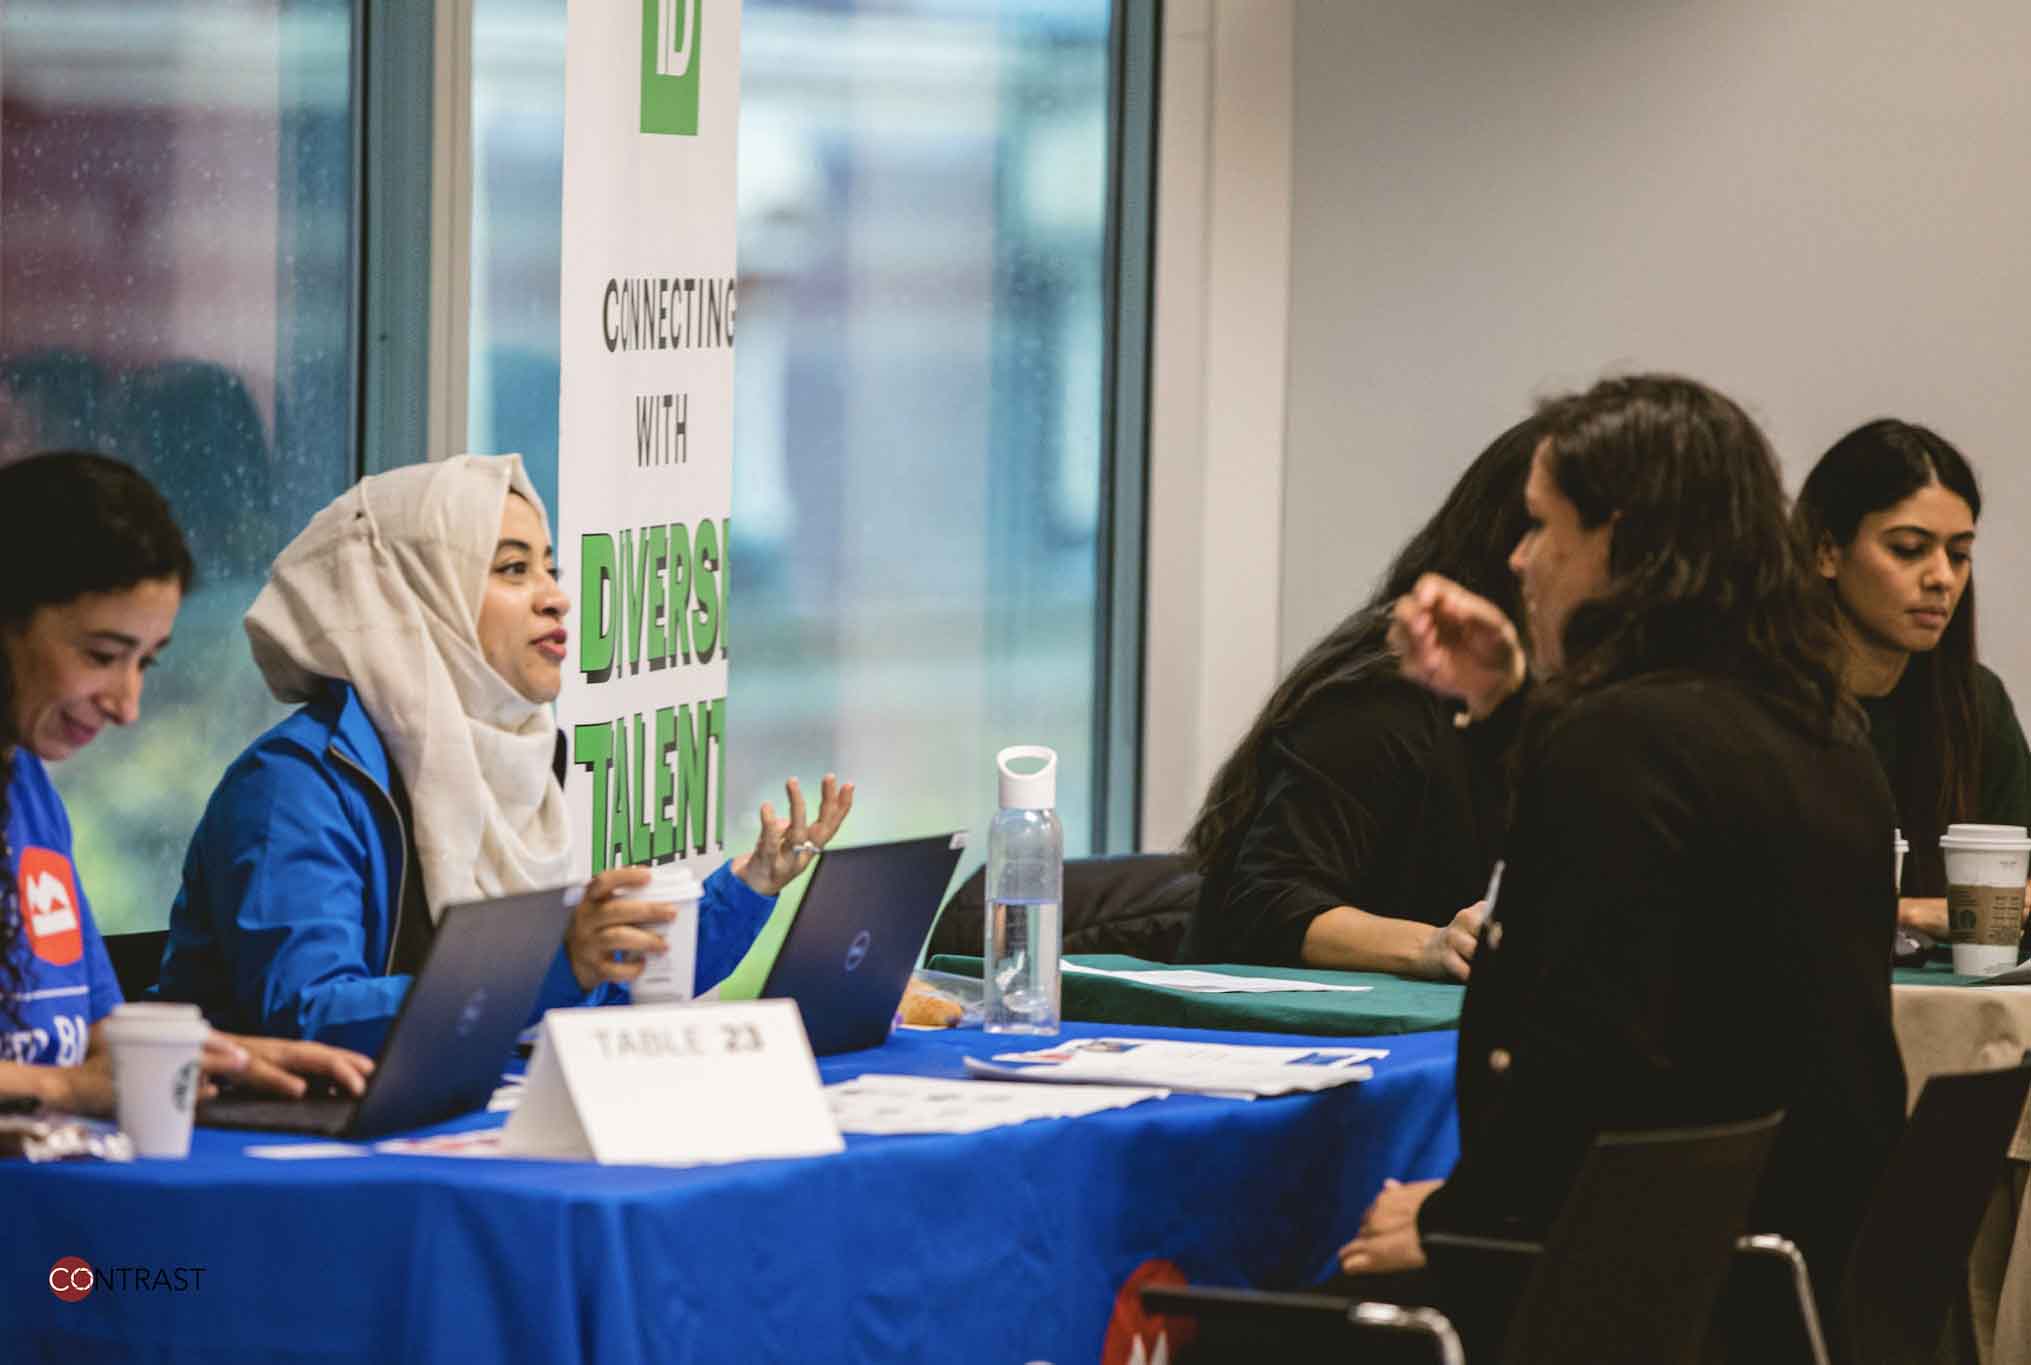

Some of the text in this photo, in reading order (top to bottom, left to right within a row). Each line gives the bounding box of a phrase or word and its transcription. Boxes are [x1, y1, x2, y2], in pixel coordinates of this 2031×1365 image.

[602, 276, 737, 353] CONNECTING
[636, 393, 687, 467] WITH
[574, 697, 728, 878] TALENT
[593, 1021, 766, 1060] TABLE 23
